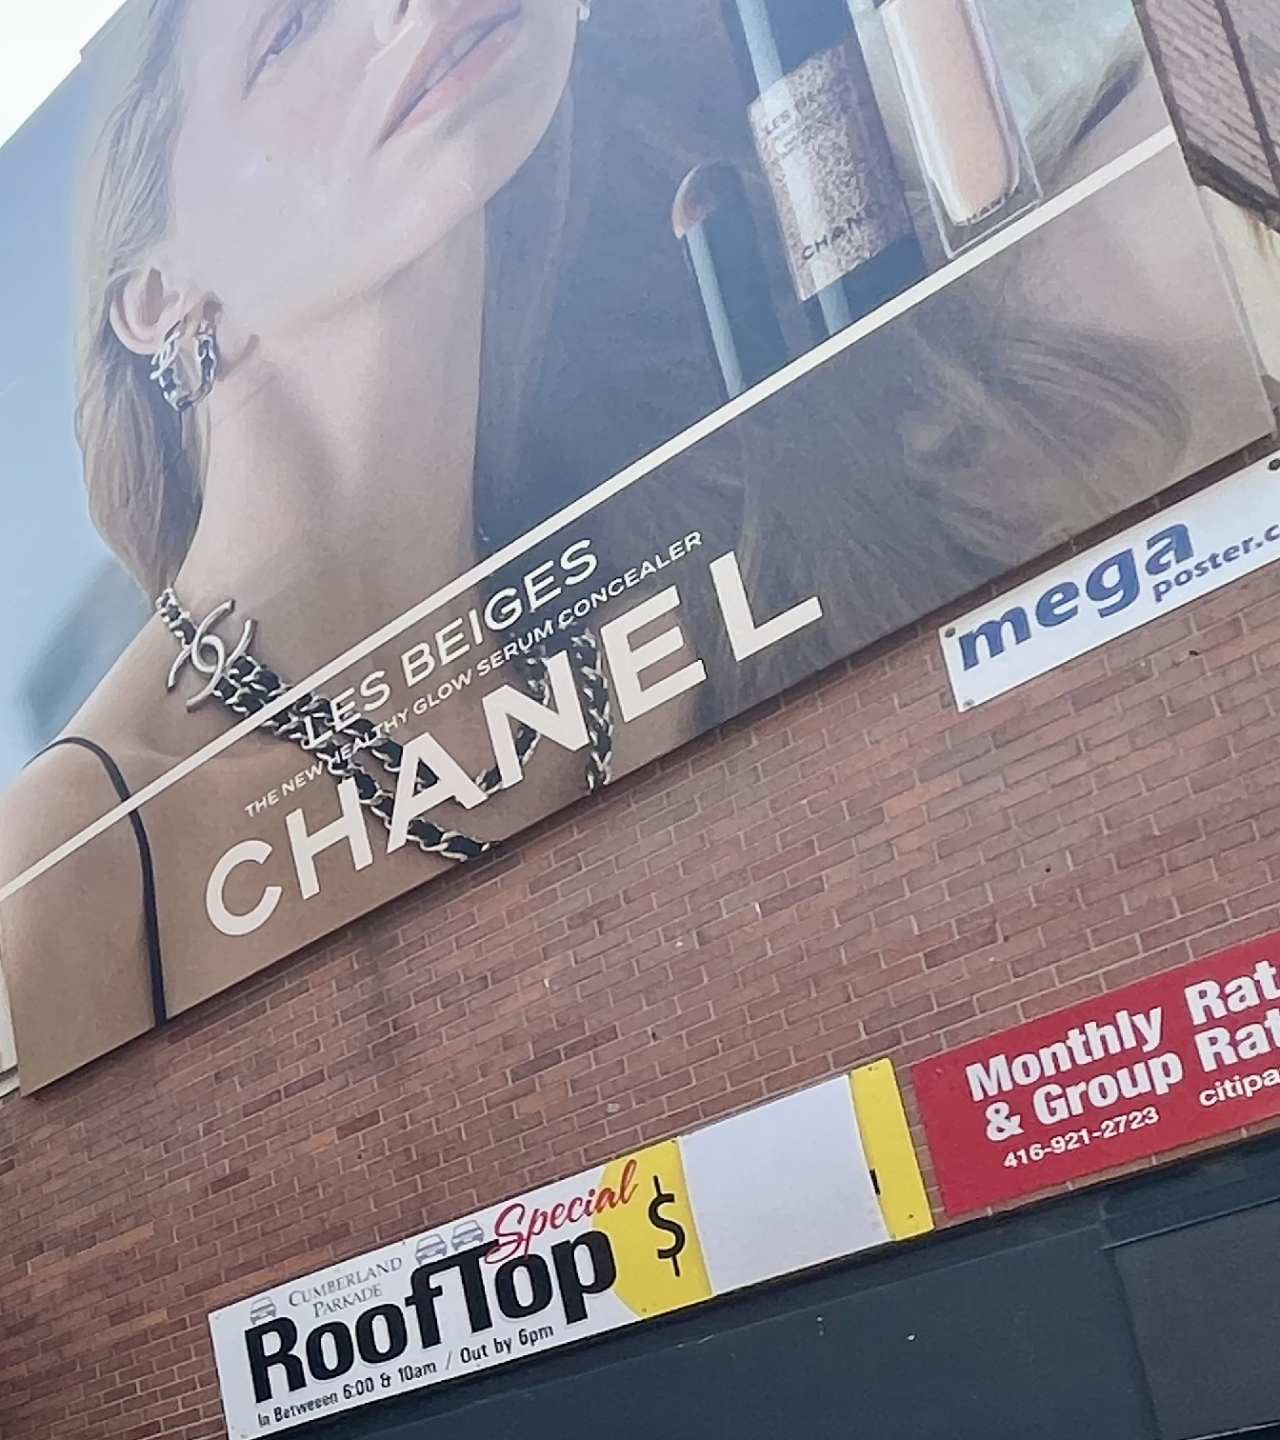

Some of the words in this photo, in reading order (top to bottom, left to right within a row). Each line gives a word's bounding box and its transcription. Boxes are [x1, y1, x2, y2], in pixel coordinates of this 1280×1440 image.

[303, 671, 391, 748] LES
[401, 539, 598, 688] BEIGES
[957, 523, 1194, 671] mega
[244, 789, 281, 817] THE
[282, 763, 324, 796] NEW
[330, 710, 409, 768] HEALTHY
[414, 671, 472, 716] GLOW
[478, 620, 554, 676] SERUM
[557, 532, 703, 629] CONCEALER
[204, 549, 823, 936] CHANEL
[965, 1007, 1162, 1102] Monthly
[985, 1101, 1025, 1141] &
[1033, 1051, 1183, 1125] Group
[1004, 1106, 1159, 1168] 416-921-2723
[484, 1159, 639, 1264] Special
[288, 1256, 403, 1307] CUMBERLAND
[313, 1283, 383, 1318] PARKADE
[397, 1360, 437, 1384] 10am
[459, 1345, 488, 1365] Out
[494, 1333, 512, 1356] by
[518, 1324, 554, 1348] 6pm
